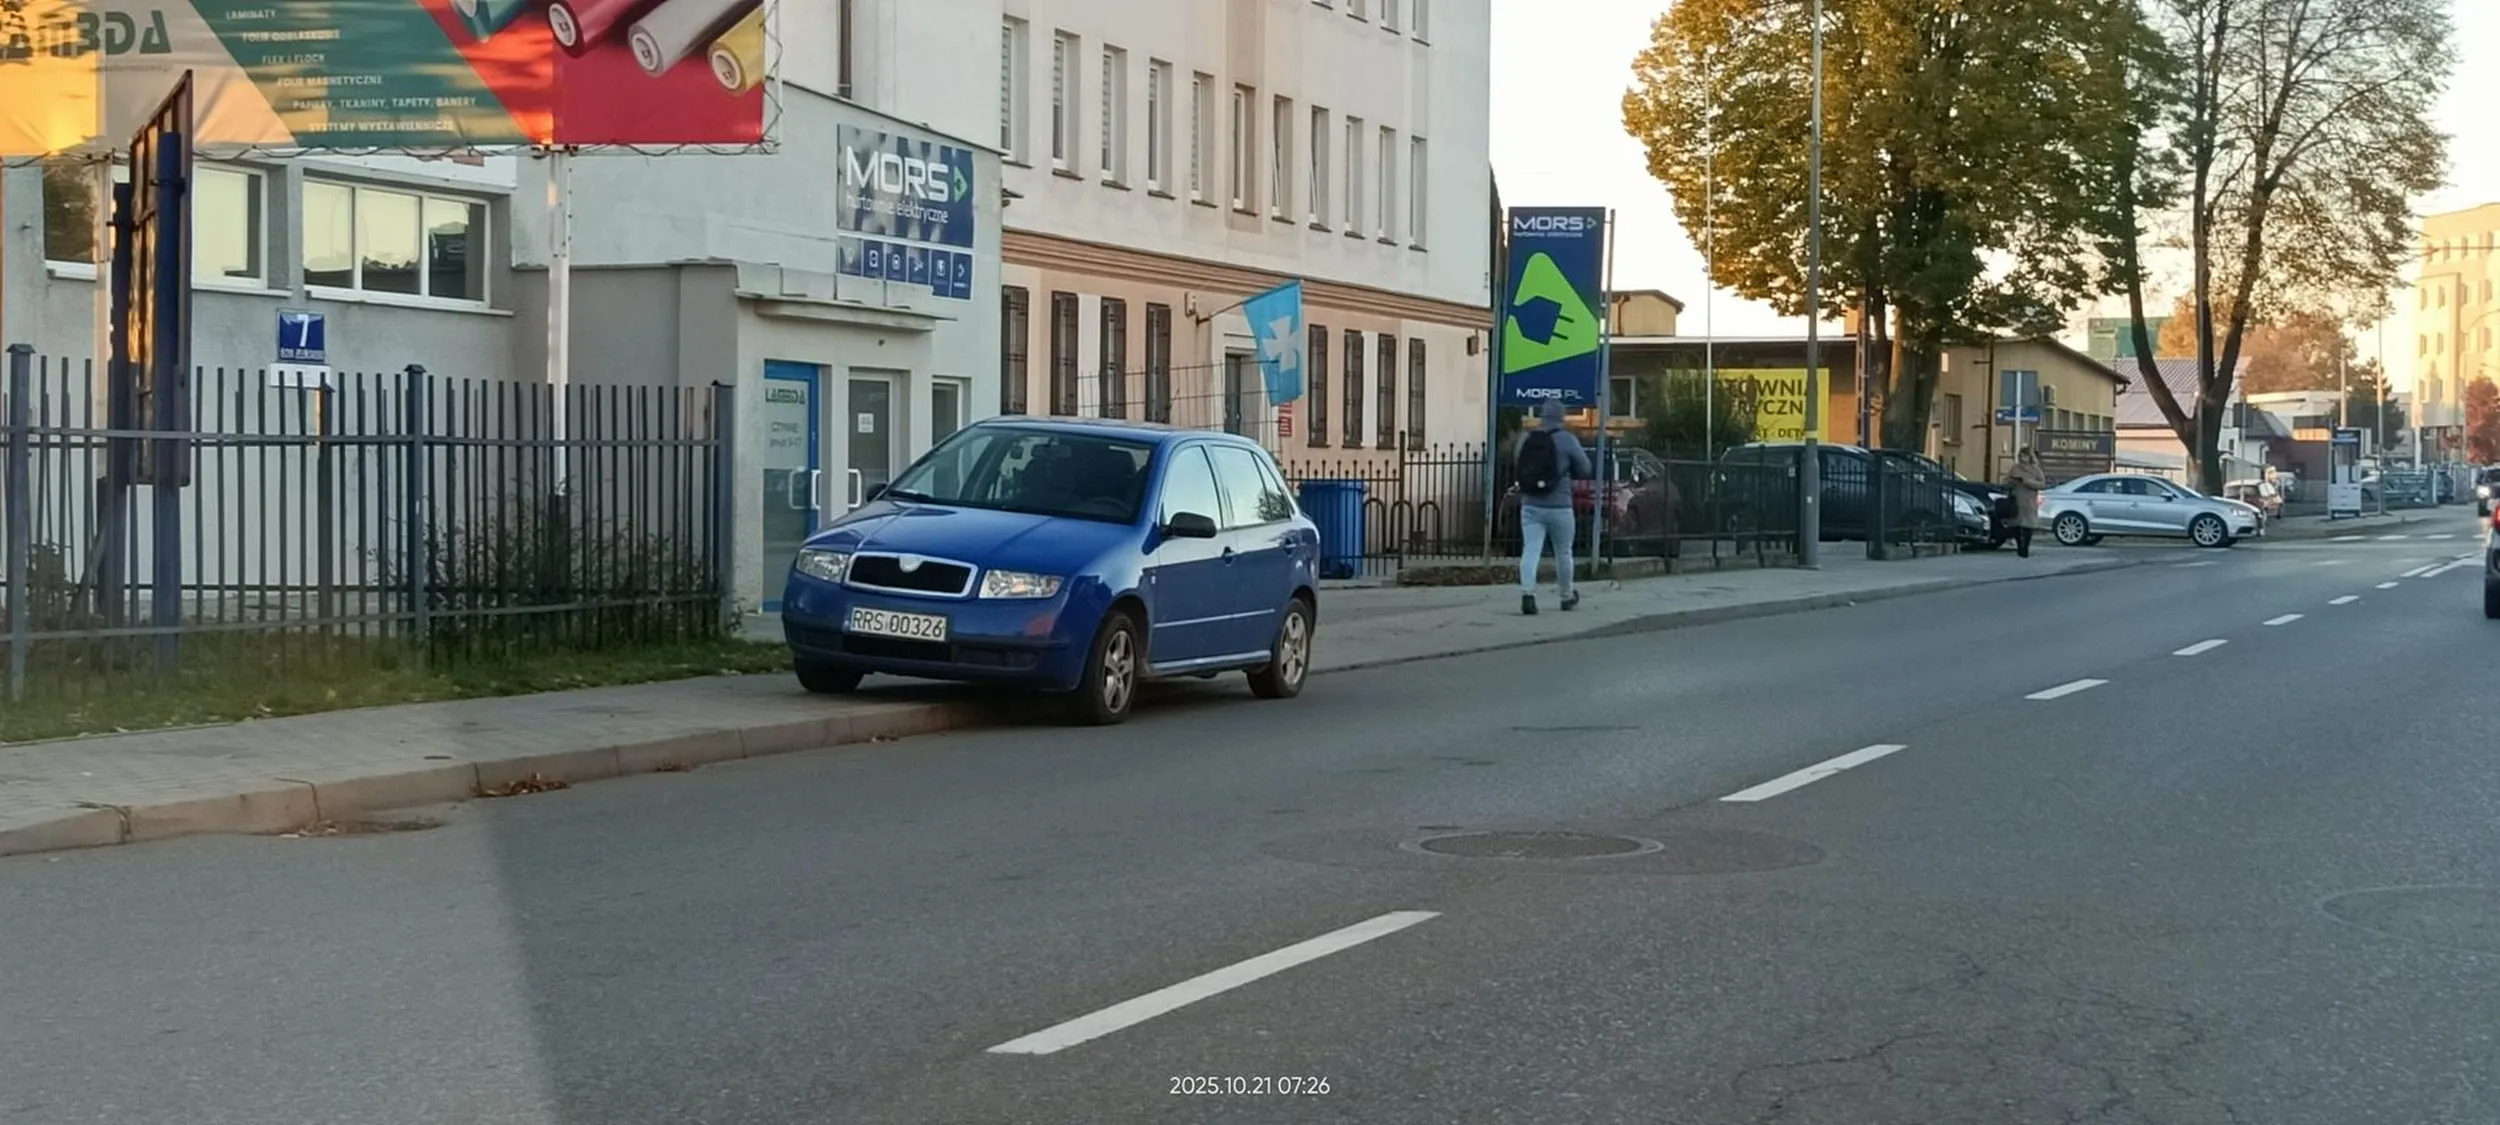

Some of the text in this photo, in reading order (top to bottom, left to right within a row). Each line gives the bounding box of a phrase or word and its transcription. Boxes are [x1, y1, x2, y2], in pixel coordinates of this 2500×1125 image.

[225, 9, 276, 20] LAMINATY
[307, 75, 382, 86] MAGNETYCZNE
[846, 145, 949, 202] MORS
[1513, 216, 1584, 230] MORS
[297, 314, 309, 347] 7
[2051, 438, 2098, 450] KOMINY
[853, 609, 944, 638] RRS 00326
